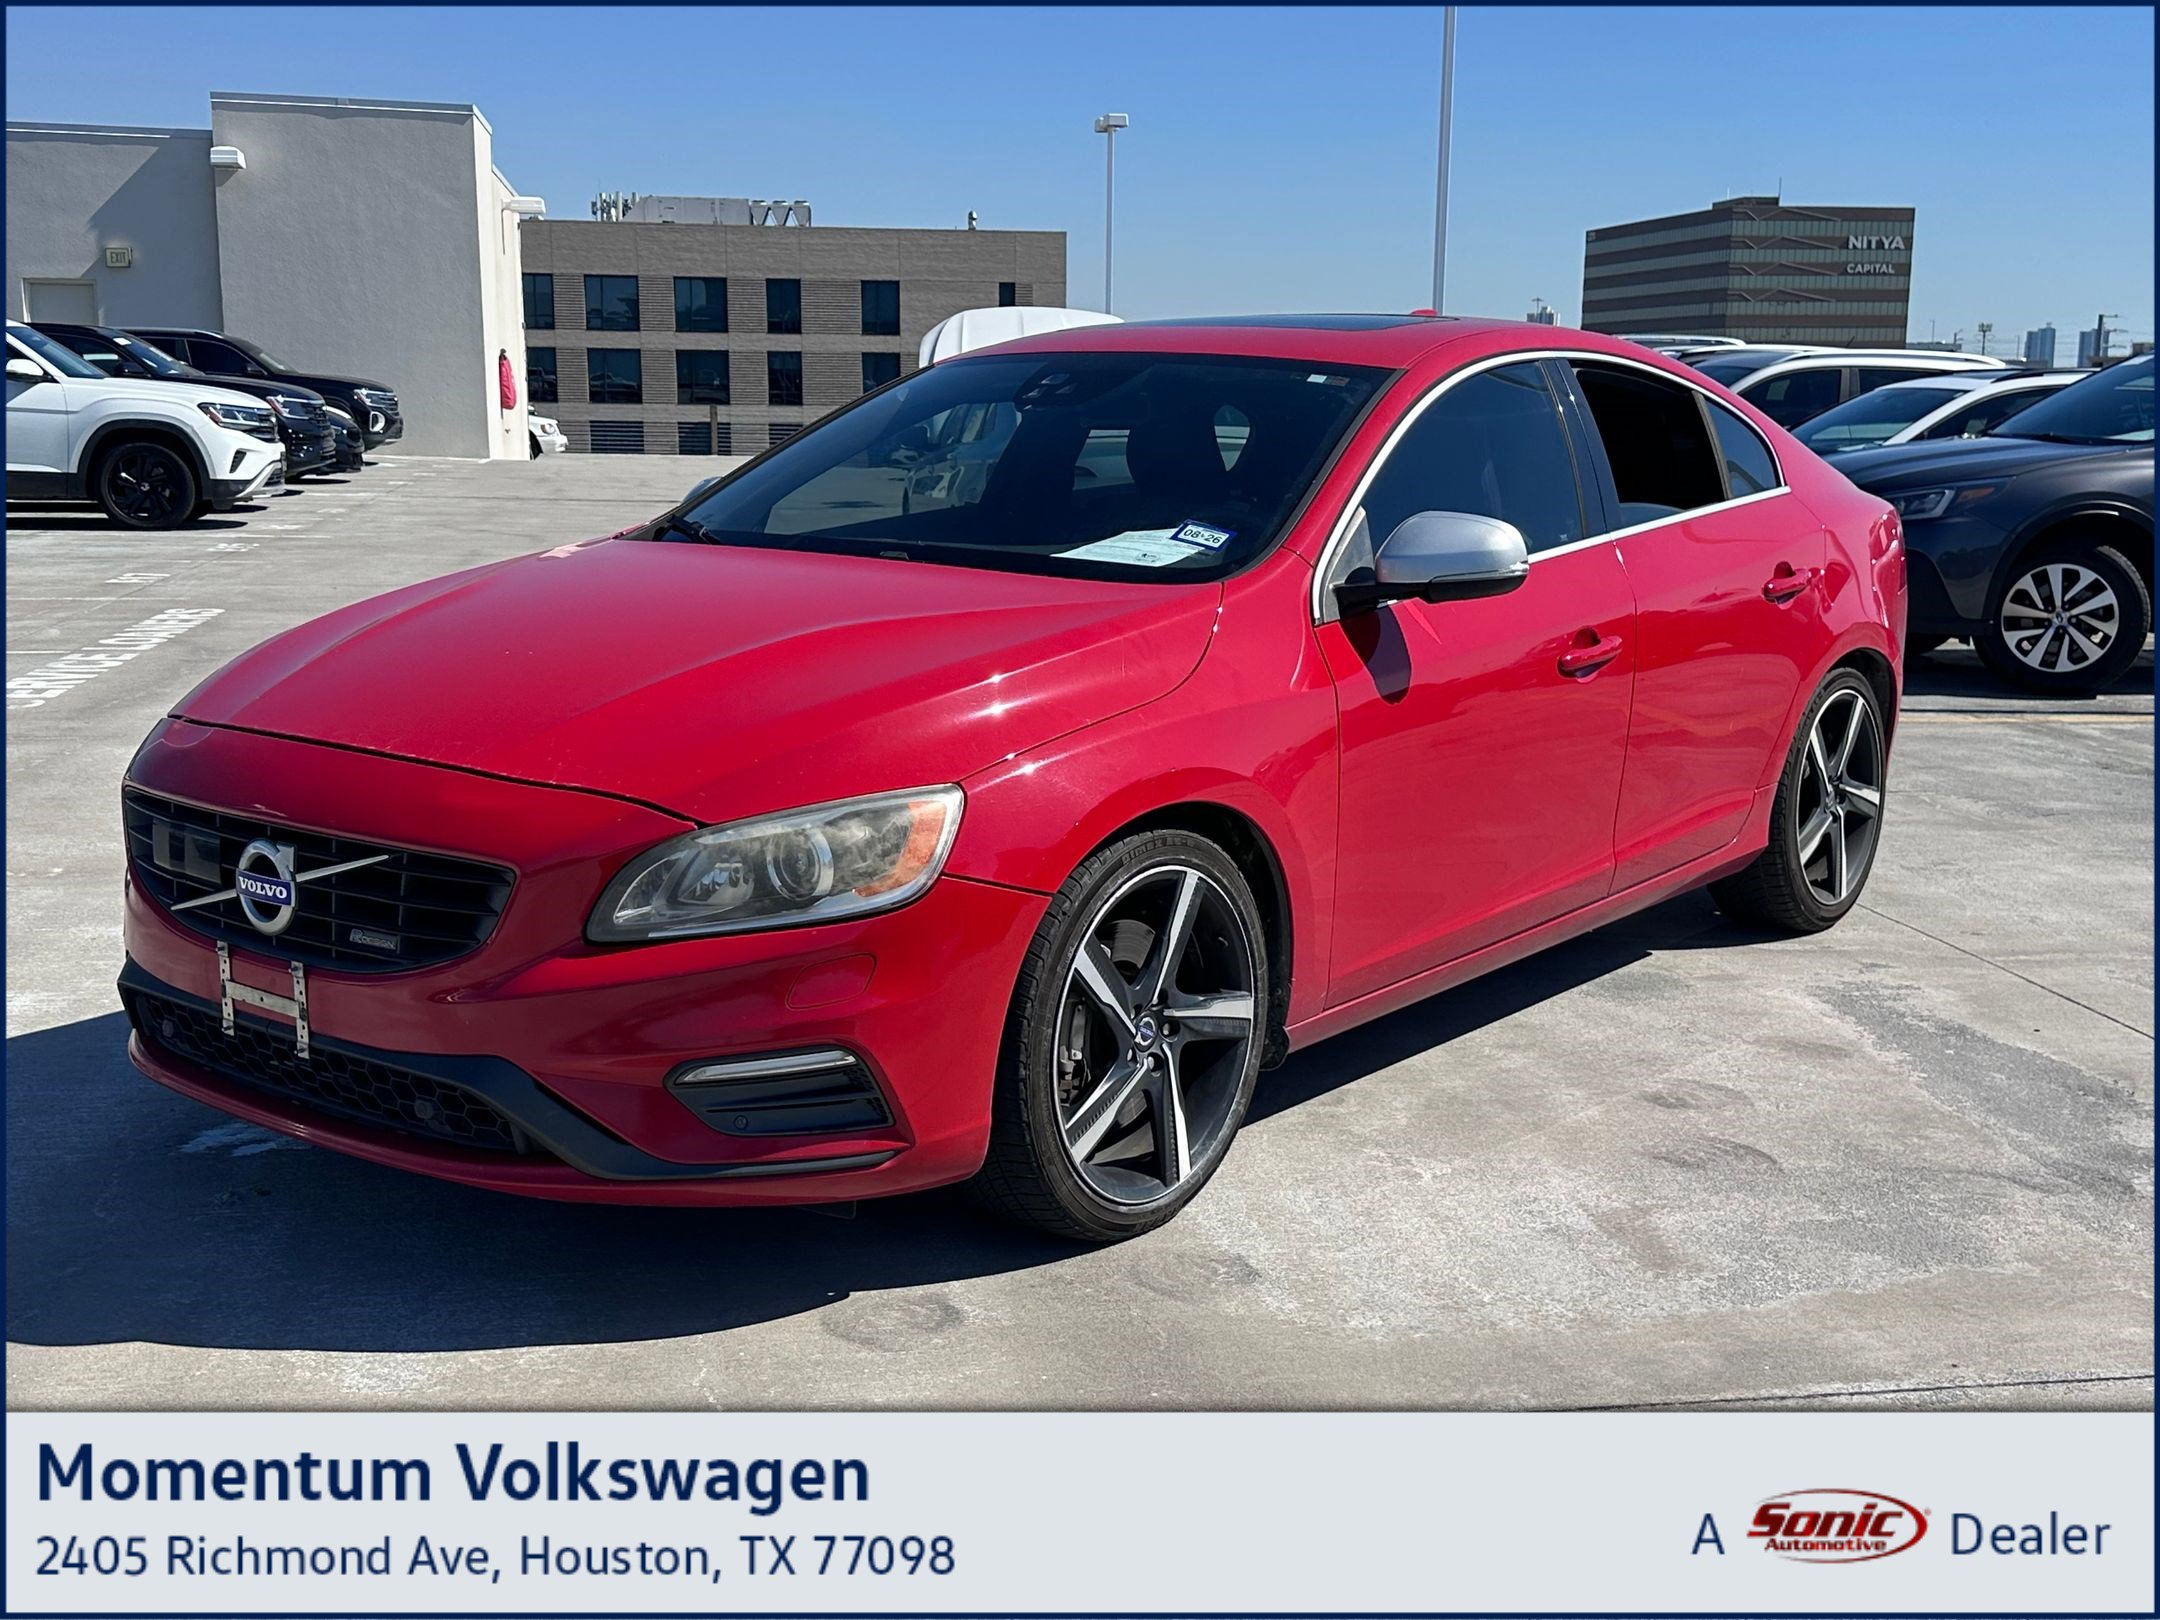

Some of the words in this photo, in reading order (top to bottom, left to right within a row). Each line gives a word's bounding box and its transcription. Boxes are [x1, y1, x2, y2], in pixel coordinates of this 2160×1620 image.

[1847, 235, 1905, 249] NITYA
[1847, 263, 1895, 274] CAPITAL
[238, 876, 288, 900] VOLVO
